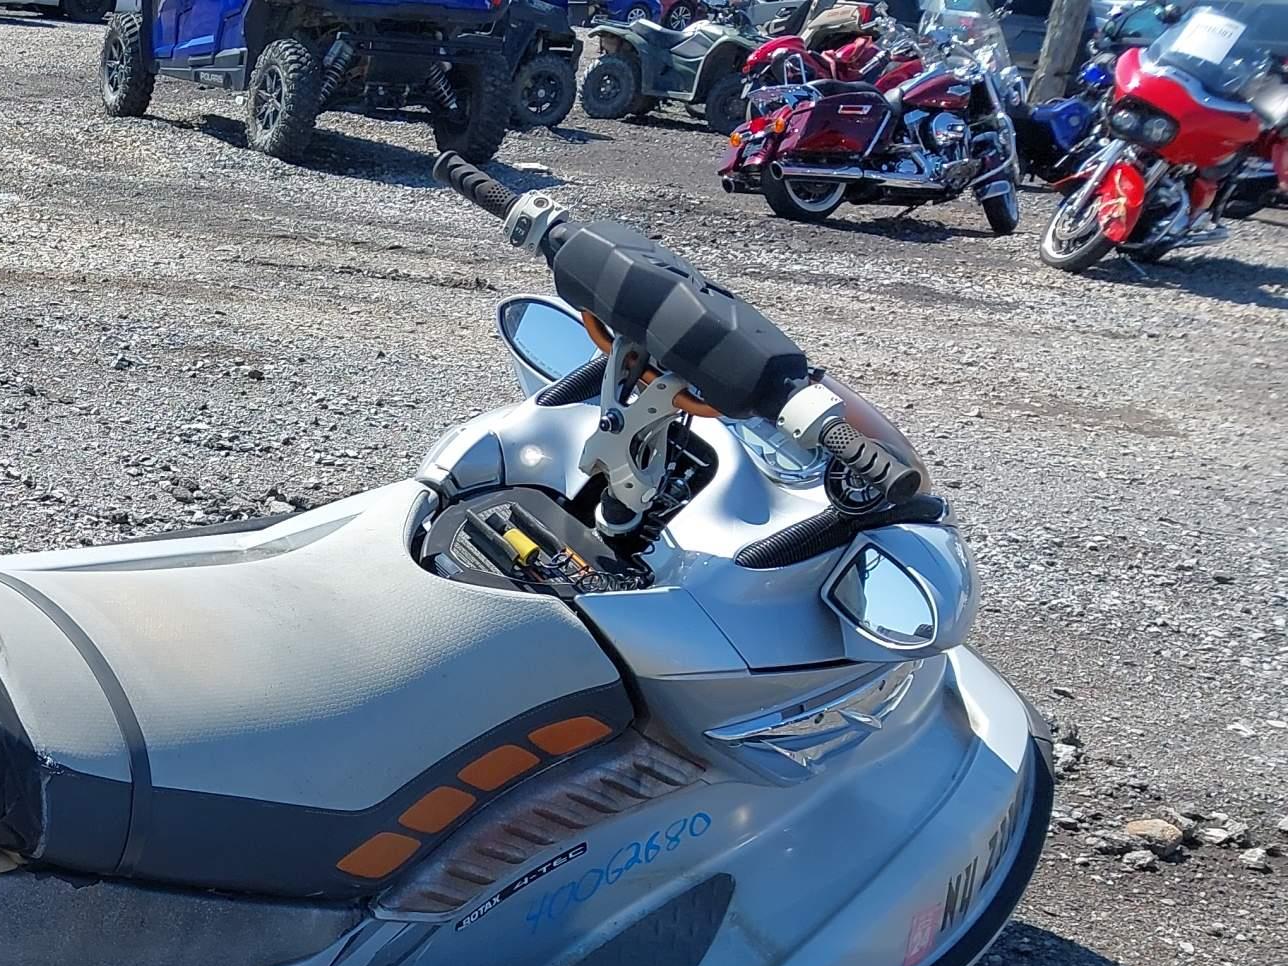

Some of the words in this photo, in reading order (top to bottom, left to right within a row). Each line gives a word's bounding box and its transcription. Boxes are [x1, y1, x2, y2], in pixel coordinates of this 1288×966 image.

[200, 72, 223, 83] POLARIS
[458, 895, 501, 930] ROTAX
[513, 846, 585, 891] 4-TEC
[526, 812, 711, 934] 40062680
